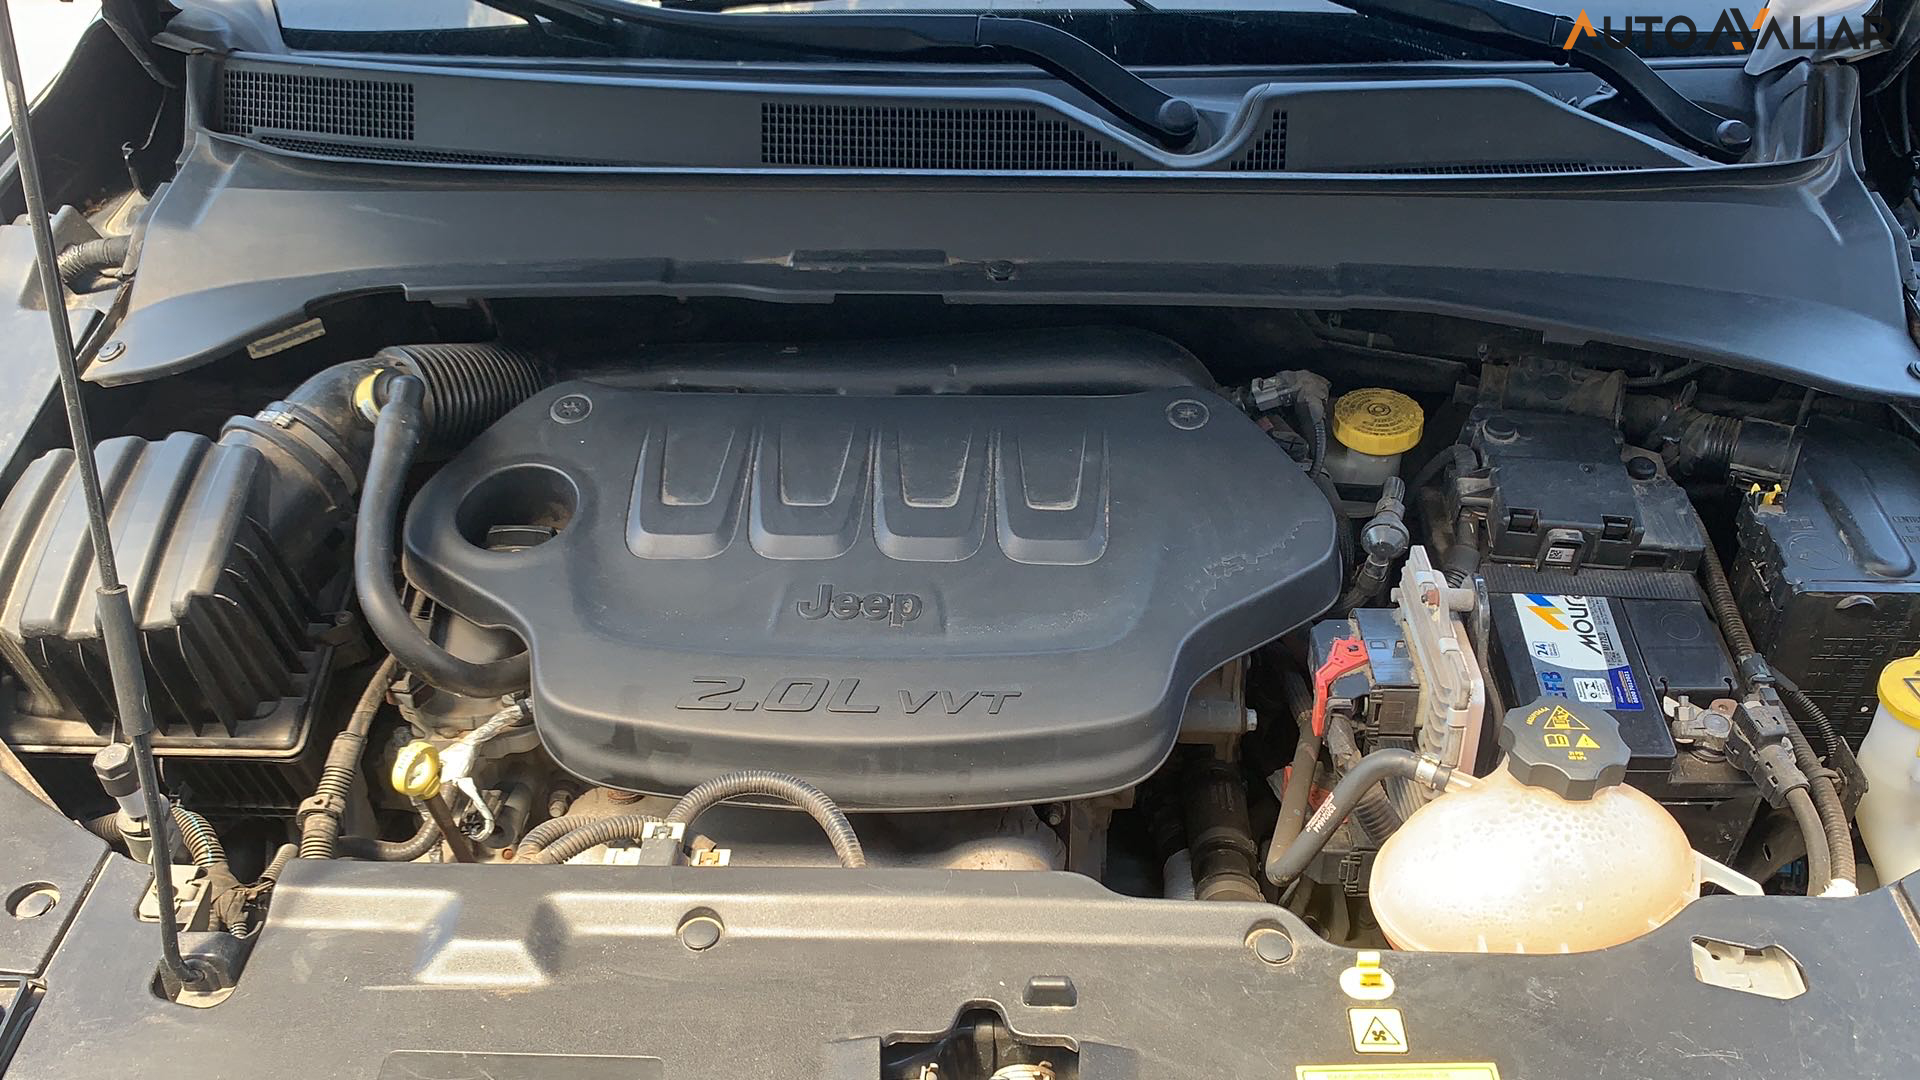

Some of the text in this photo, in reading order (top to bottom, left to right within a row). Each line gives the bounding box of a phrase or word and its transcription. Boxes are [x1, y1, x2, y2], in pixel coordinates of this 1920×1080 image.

[796, 583, 923, 627] Jeep
[1535, 643, 1549, 656] 24
[675, 676, 1022, 715] 2.0L VVT
